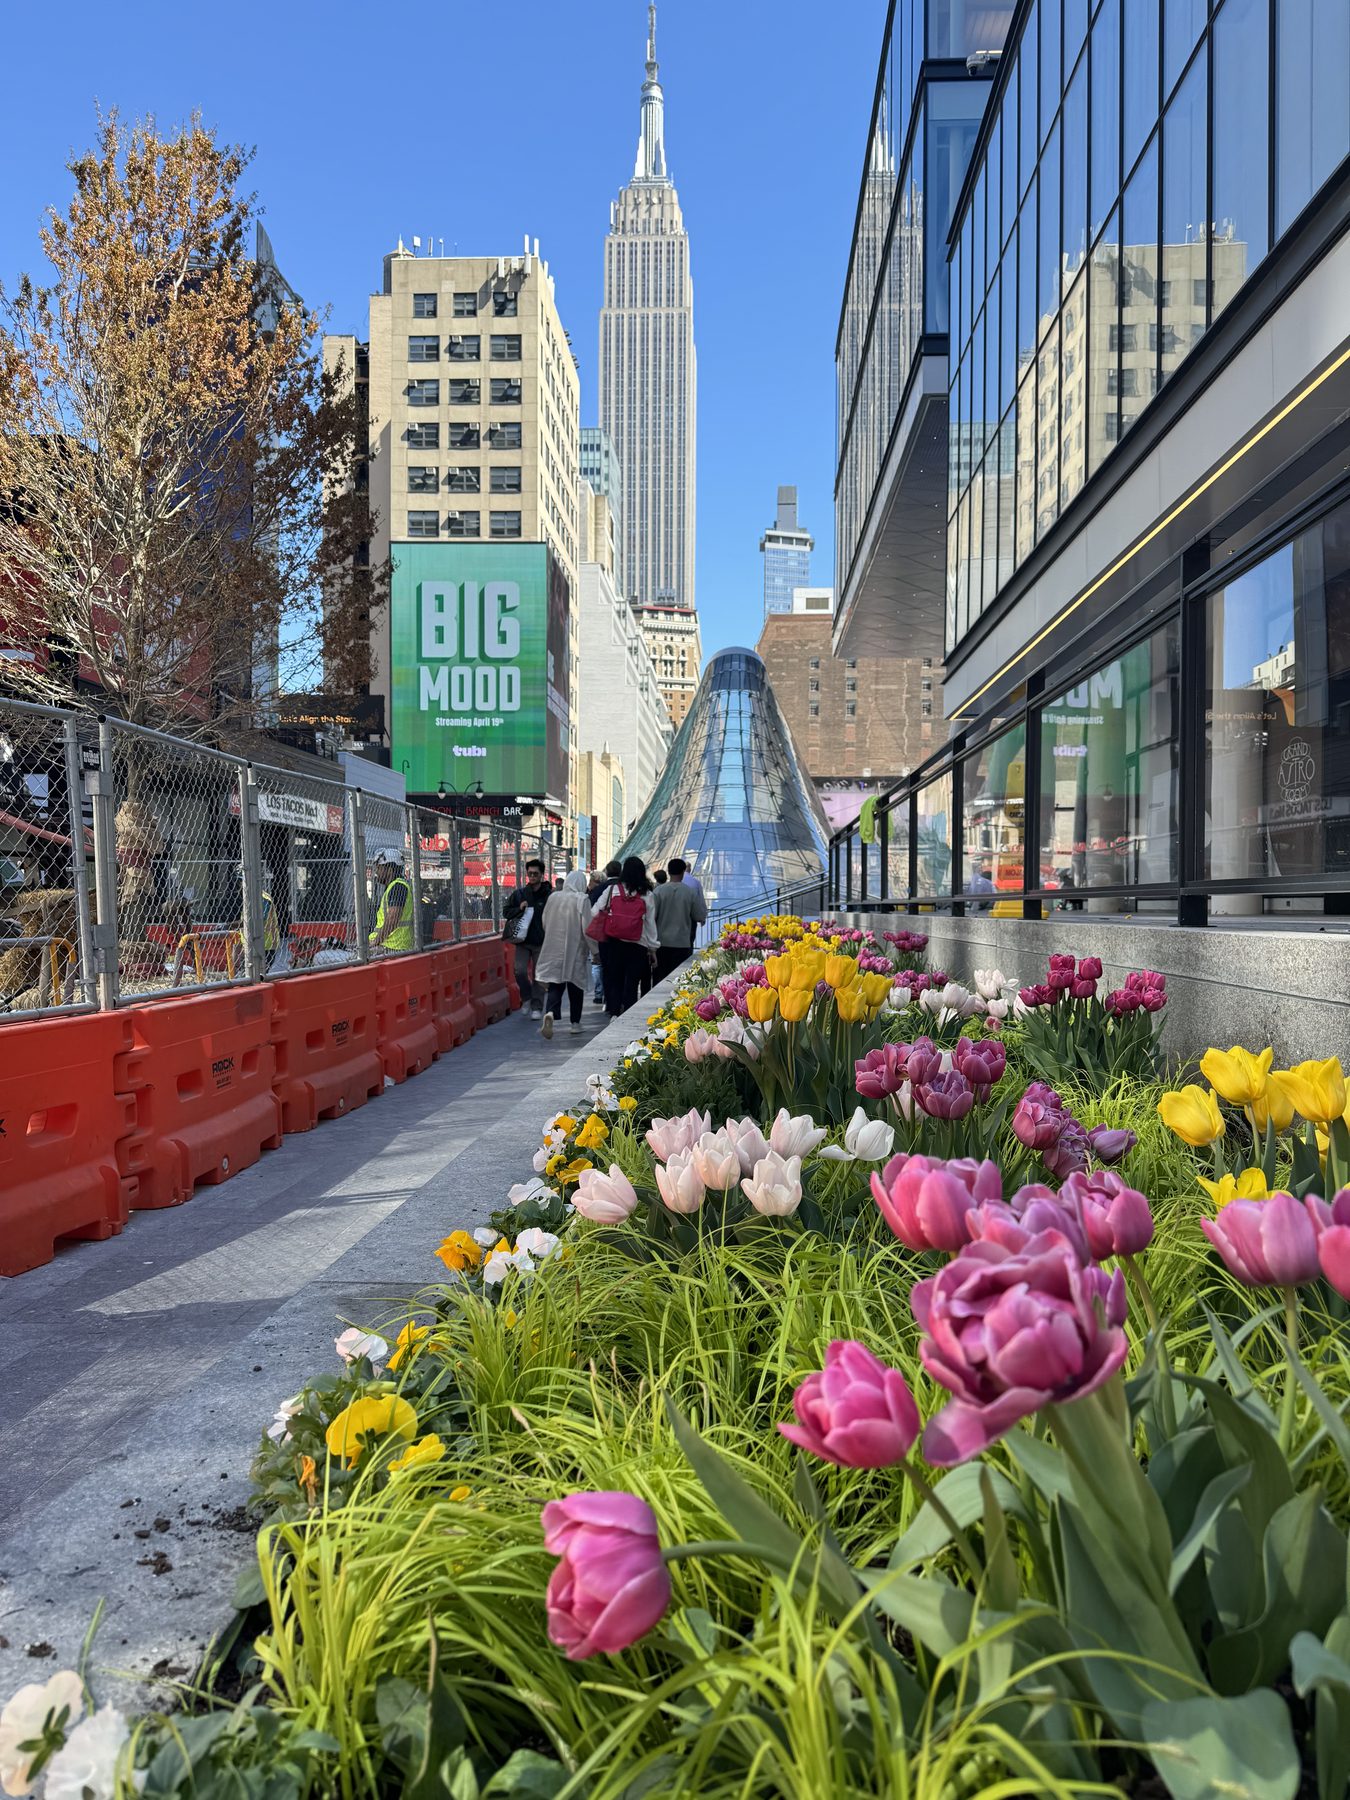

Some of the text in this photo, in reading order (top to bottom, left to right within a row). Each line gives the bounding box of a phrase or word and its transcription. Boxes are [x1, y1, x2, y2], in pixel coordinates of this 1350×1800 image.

[419, 580, 521, 660] BIG
[420, 666, 521, 711] MOOD
[435, 717, 472, 727] Streaming
[473, 717, 490, 727] April
[1282, 742, 1309, 761] GRAND
[266, 795, 281, 810] LOS
[282, 797, 304, 815] TACOS
[503, 806, 523, 816] BAR
[404, 832, 486, 854] ubay
[212, 1057, 235, 1073] ROCK
